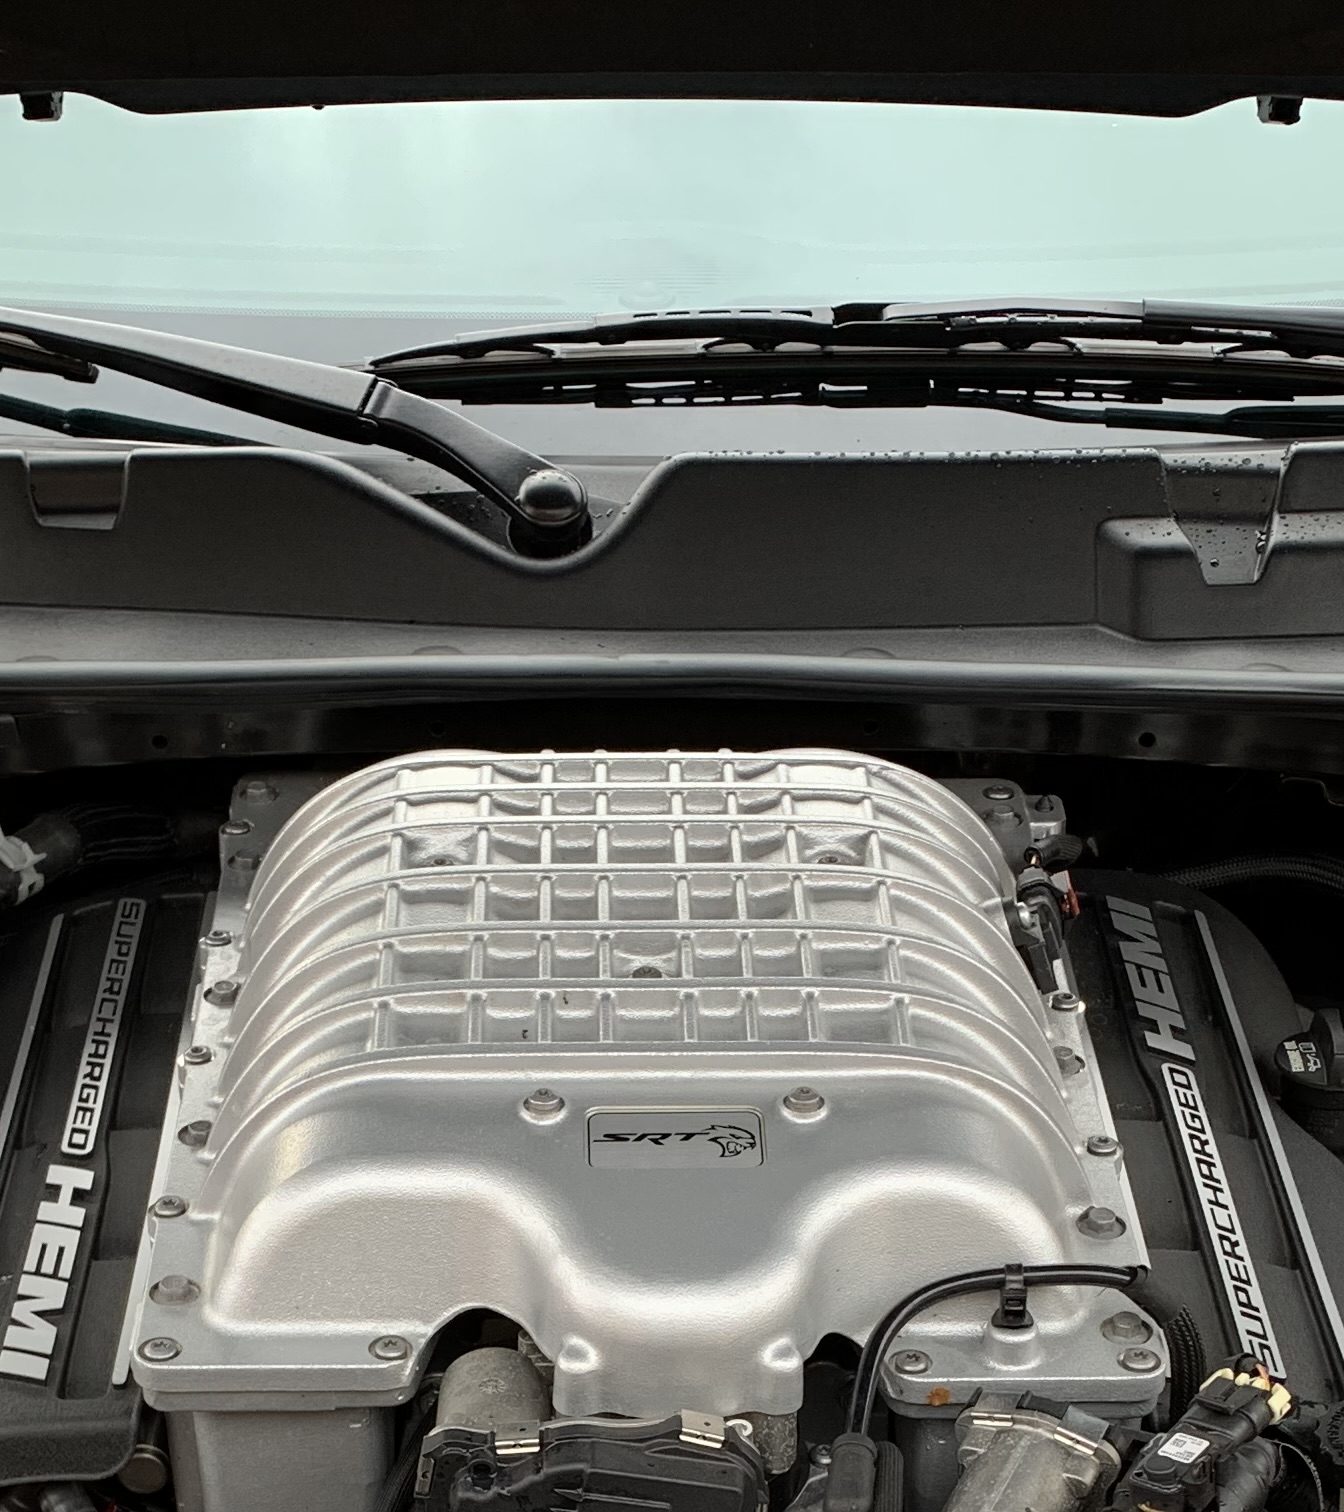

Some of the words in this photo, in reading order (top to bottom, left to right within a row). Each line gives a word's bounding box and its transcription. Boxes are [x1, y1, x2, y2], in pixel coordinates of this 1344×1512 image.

[66, 901, 143, 1151] SUPERCHARGED
[1106, 895, 1197, 1063] HEMI
[592, 1131, 711, 1147] SRT
[1166, 1065, 1280, 1374] SUPERCHARGED
